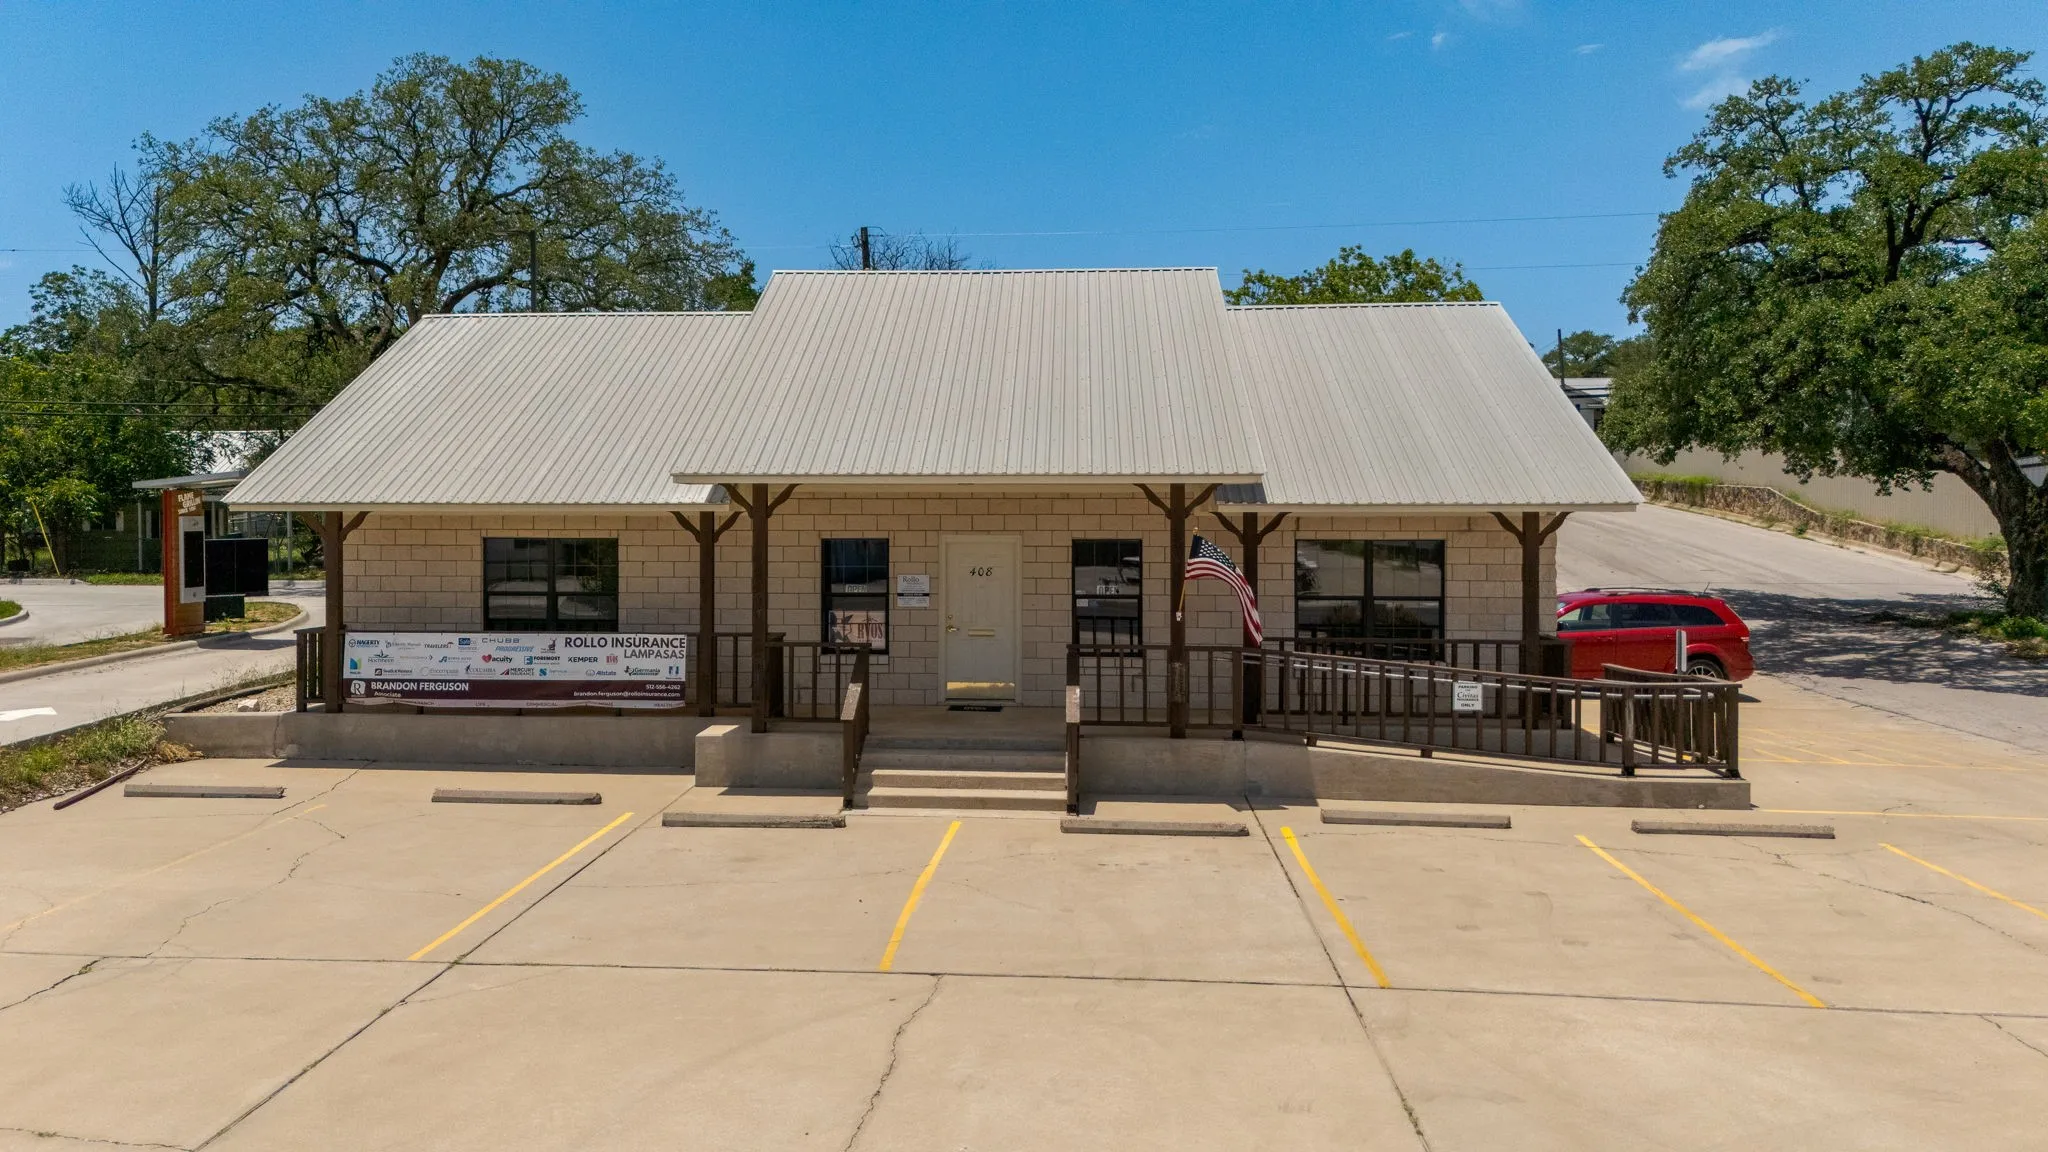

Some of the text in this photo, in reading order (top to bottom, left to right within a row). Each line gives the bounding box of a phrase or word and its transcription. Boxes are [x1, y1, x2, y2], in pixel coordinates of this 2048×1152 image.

[969, 567, 993, 576] 408
[902, 575, 920, 583] Rollo
[857, 623, 883, 639] RVOS
[564, 637, 686, 648] ROLLO INSURANCE
[492, 655, 513, 663] acuity
[623, 649, 685, 659] LAMPASAS
[371, 681, 469, 691] BRANDON FERGUSON
